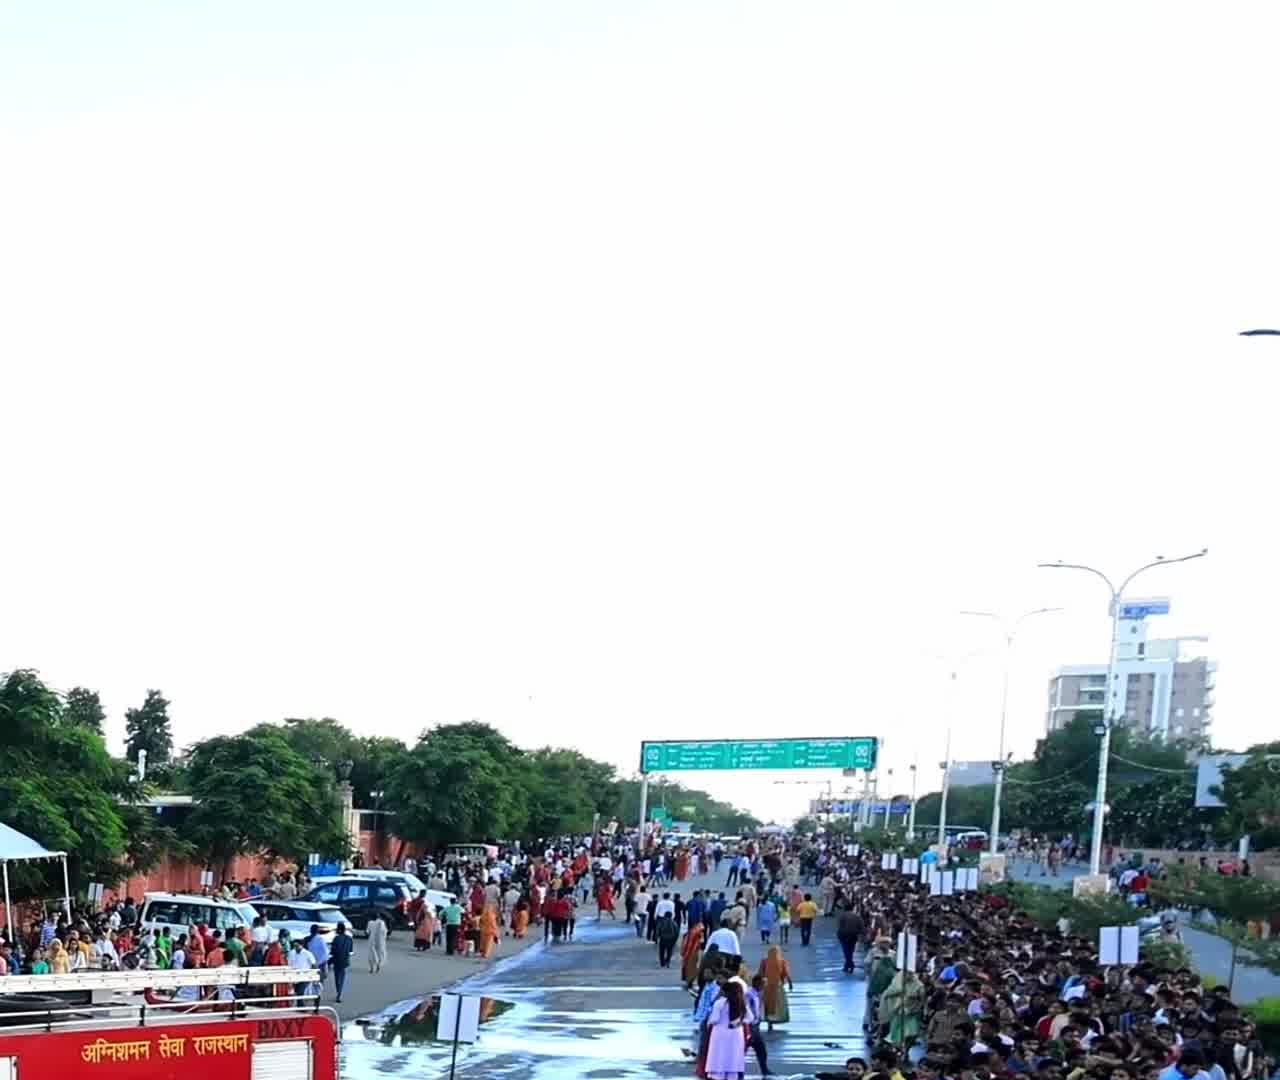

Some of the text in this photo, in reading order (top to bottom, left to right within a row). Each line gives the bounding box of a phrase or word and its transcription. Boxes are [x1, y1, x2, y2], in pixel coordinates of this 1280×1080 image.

[81, 1033, 248, 1064] अग्निशमन सेवा राजस्थान
